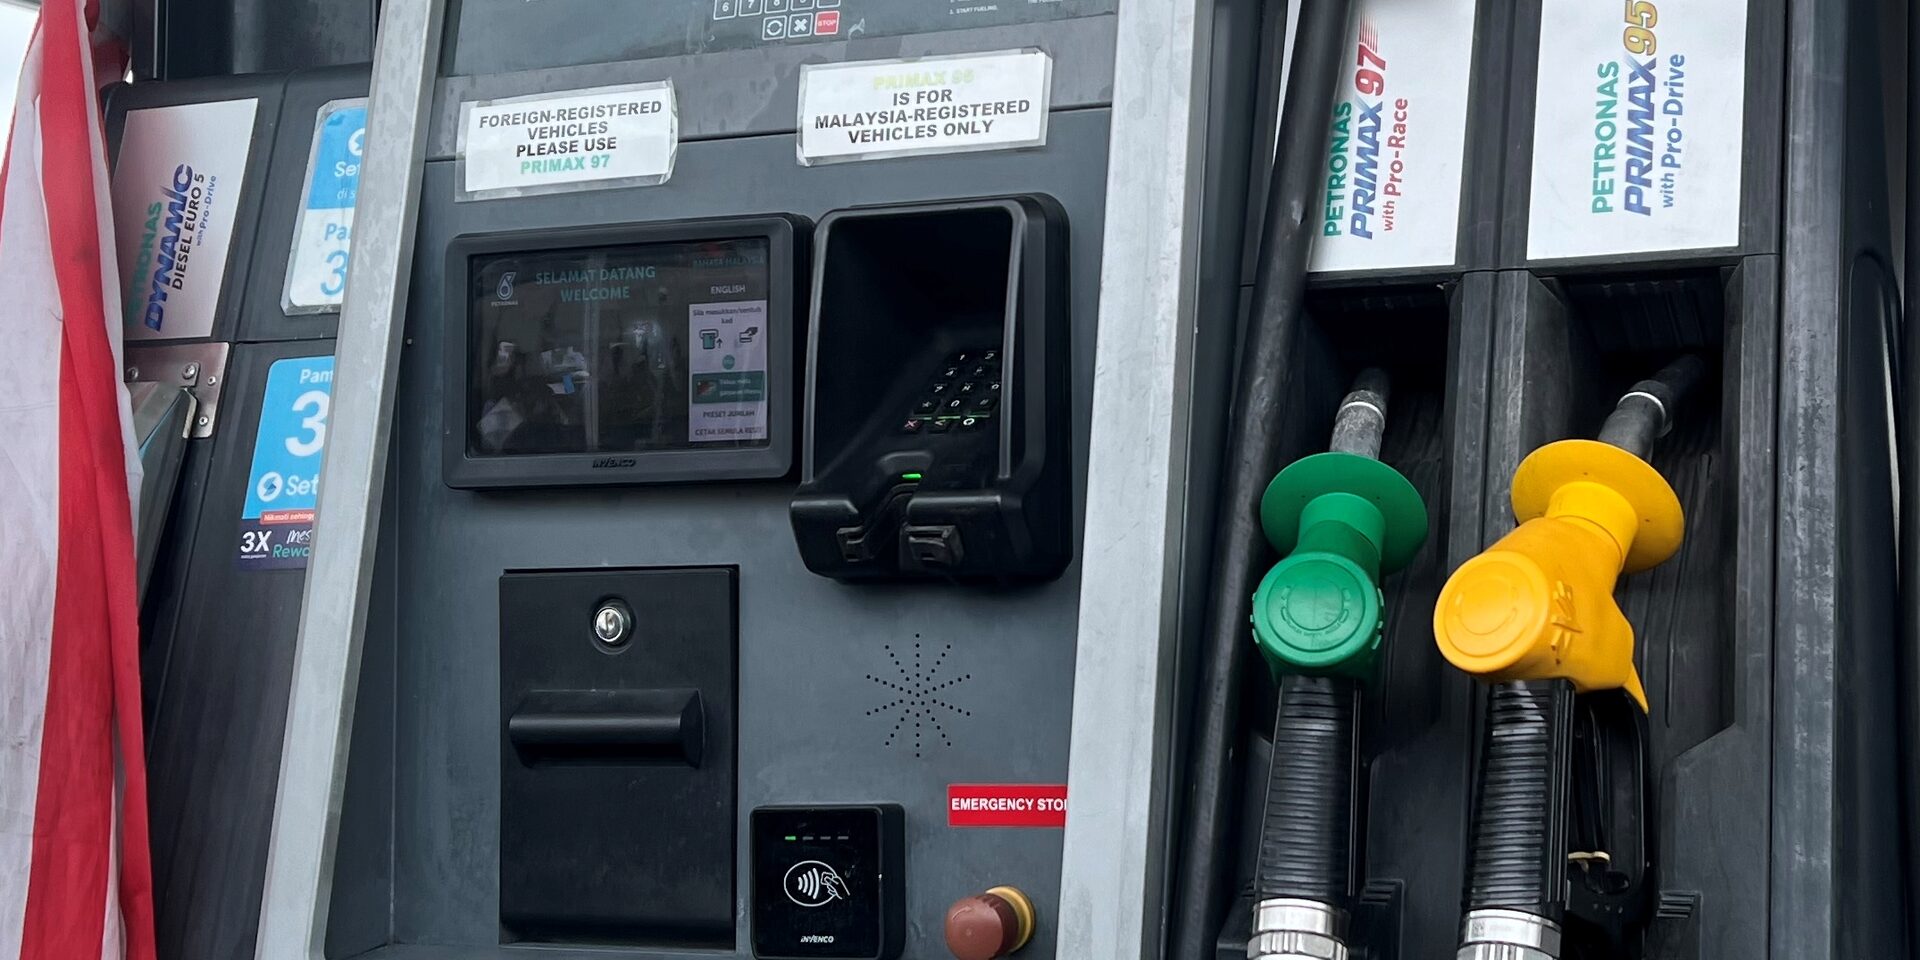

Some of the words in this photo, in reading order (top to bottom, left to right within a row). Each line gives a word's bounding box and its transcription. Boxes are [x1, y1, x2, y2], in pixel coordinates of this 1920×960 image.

[722, 2, 729, 12] 6
[1623, 0, 1658, 56] 95
[873, 70, 947, 90] PRIMAX
[1355, 42, 1386, 96] 97
[893, 92, 910, 106] IS
[917, 89, 952, 104] FOR
[1661, 54, 1685, 168] Pro-Drive
[480, 100, 662, 128] FOREIGN-REGISTERED
[815, 99, 1030, 129] MALAYSIA-REGISTERED
[527, 121, 608, 140] VEHICLES
[848, 124, 937, 144] VEHICLES
[943, 119, 994, 136] ONLY
[1592, 61, 1619, 213] PETRONAS
[1624, 53, 1657, 216] PRIMAX
[516, 140, 578, 157] PLEASE
[585, 137, 617, 152] USE
[1384, 98, 1408, 196] Pro-Race
[520, 156, 585, 175] PRIMAX
[591, 154, 610, 169] 97
[1324, 101, 1352, 237] PETRONAS
[1350, 94, 1383, 240] PRIMAX
[201, 175, 216, 230] Pro-Drive
[1660, 172, 1674, 208] with
[1384, 200, 1395, 231] with
[172, 236, 192, 291] DIESEL
[184, 187, 202, 232] EURO
[194, 173, 205, 184] 5
[324, 223, 352, 241] Pa
[144, 164, 193, 332] DYNAMIC
[320, 250, 349, 296] 3
[535, 269, 596, 285] SELAMAT
[601, 266, 656, 282] DATANG
[560, 286, 631, 302] WELCOME
[711, 285, 746, 294] ENGLISH
[285, 390, 330, 457] 3
[240, 530, 272, 553] 3X
[952, 798, 1034, 811] EMERGENCY
